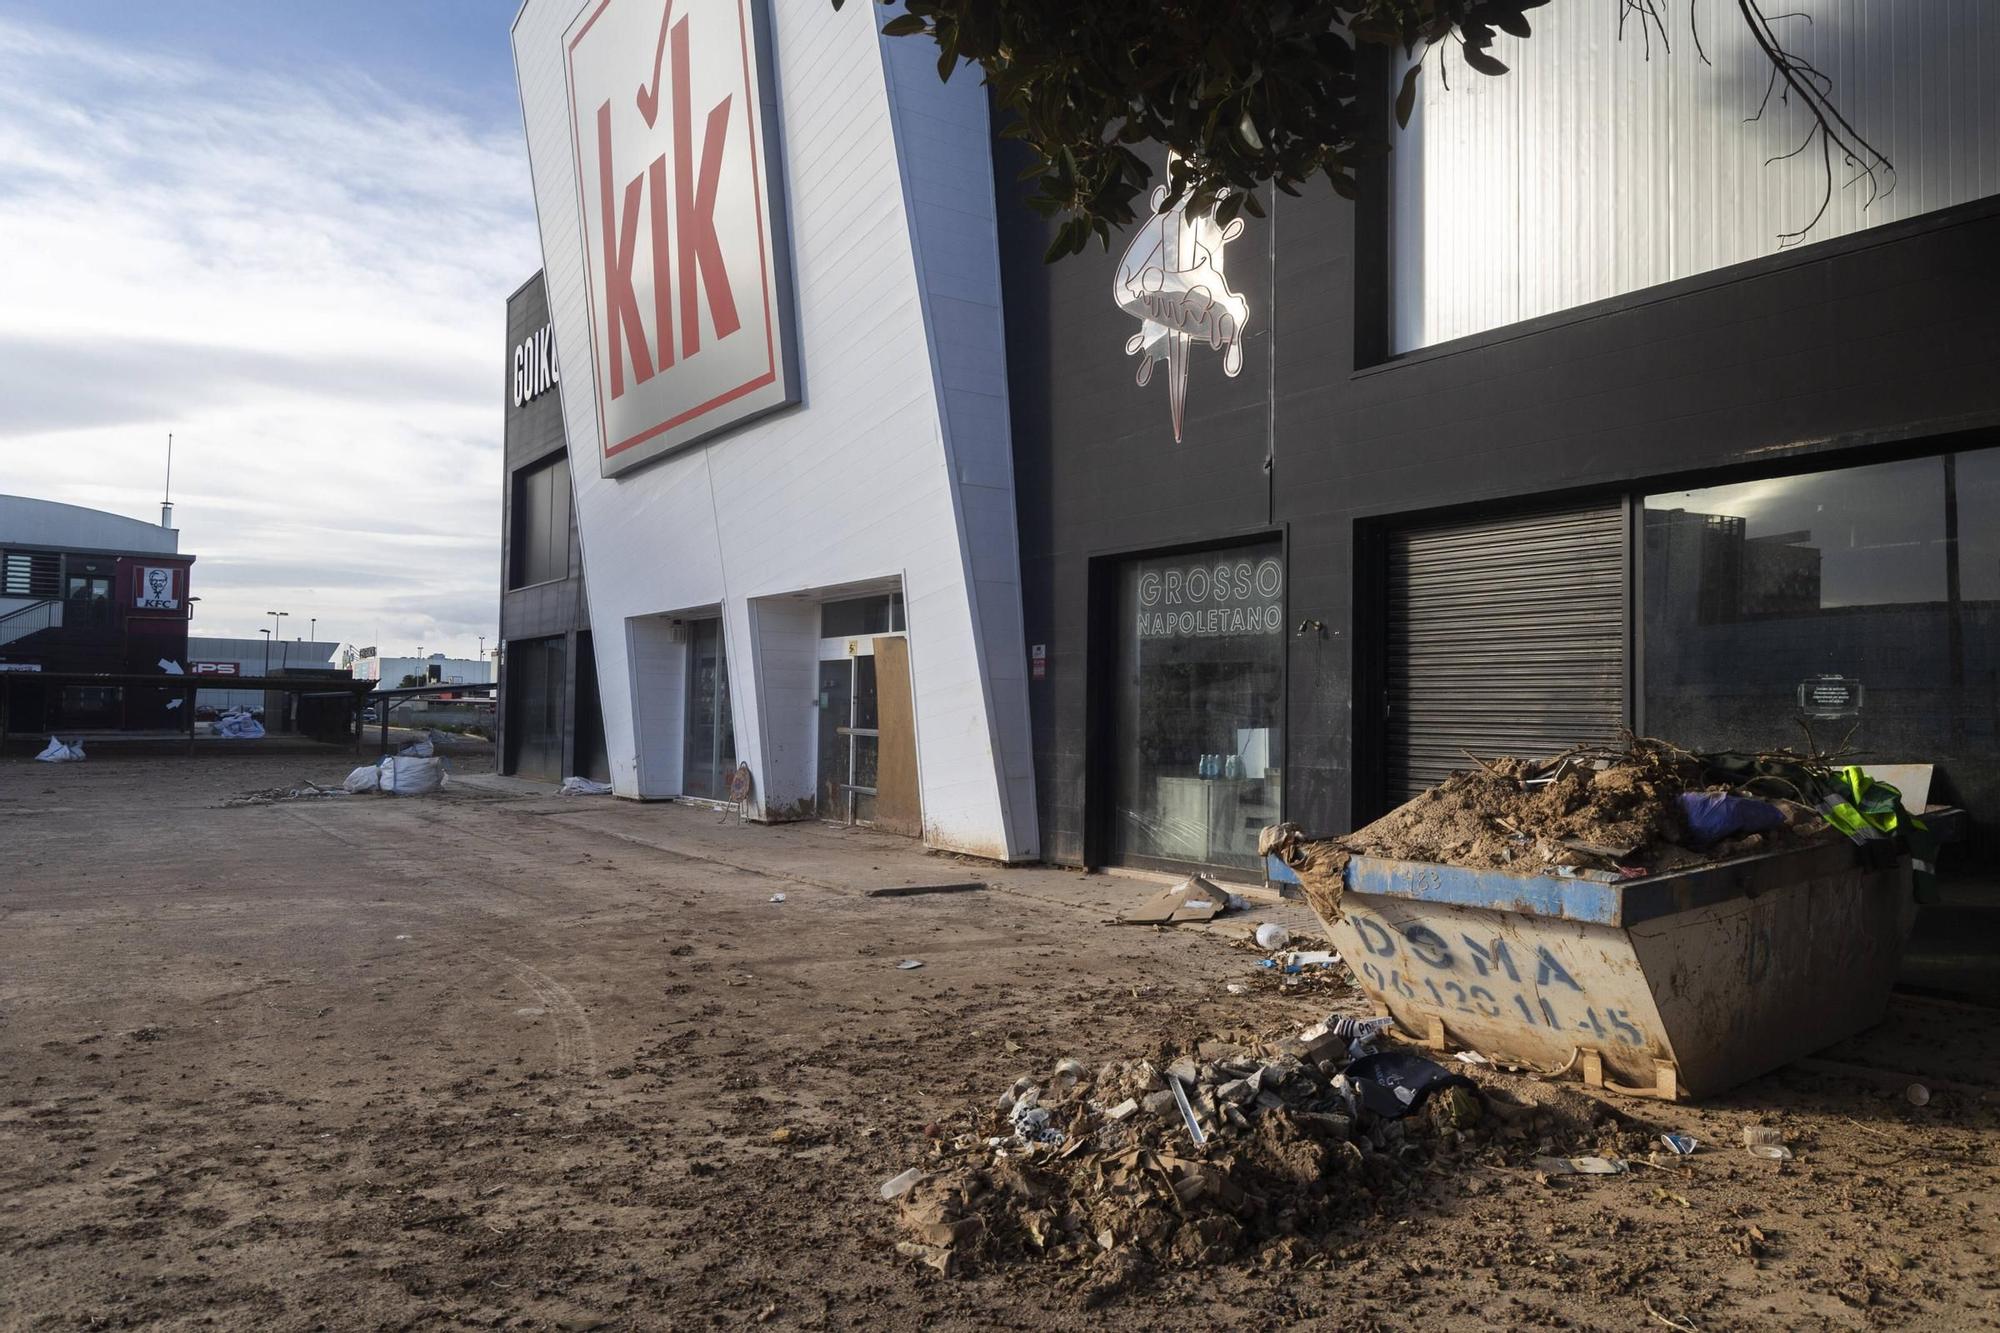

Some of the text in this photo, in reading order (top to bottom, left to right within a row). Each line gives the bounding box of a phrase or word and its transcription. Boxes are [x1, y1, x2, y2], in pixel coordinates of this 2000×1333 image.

[1139, 560, 1282, 606] GROSSO
[145, 599, 171, 609] KFC
[1137, 605, 1282, 635] NAPOLETANO
